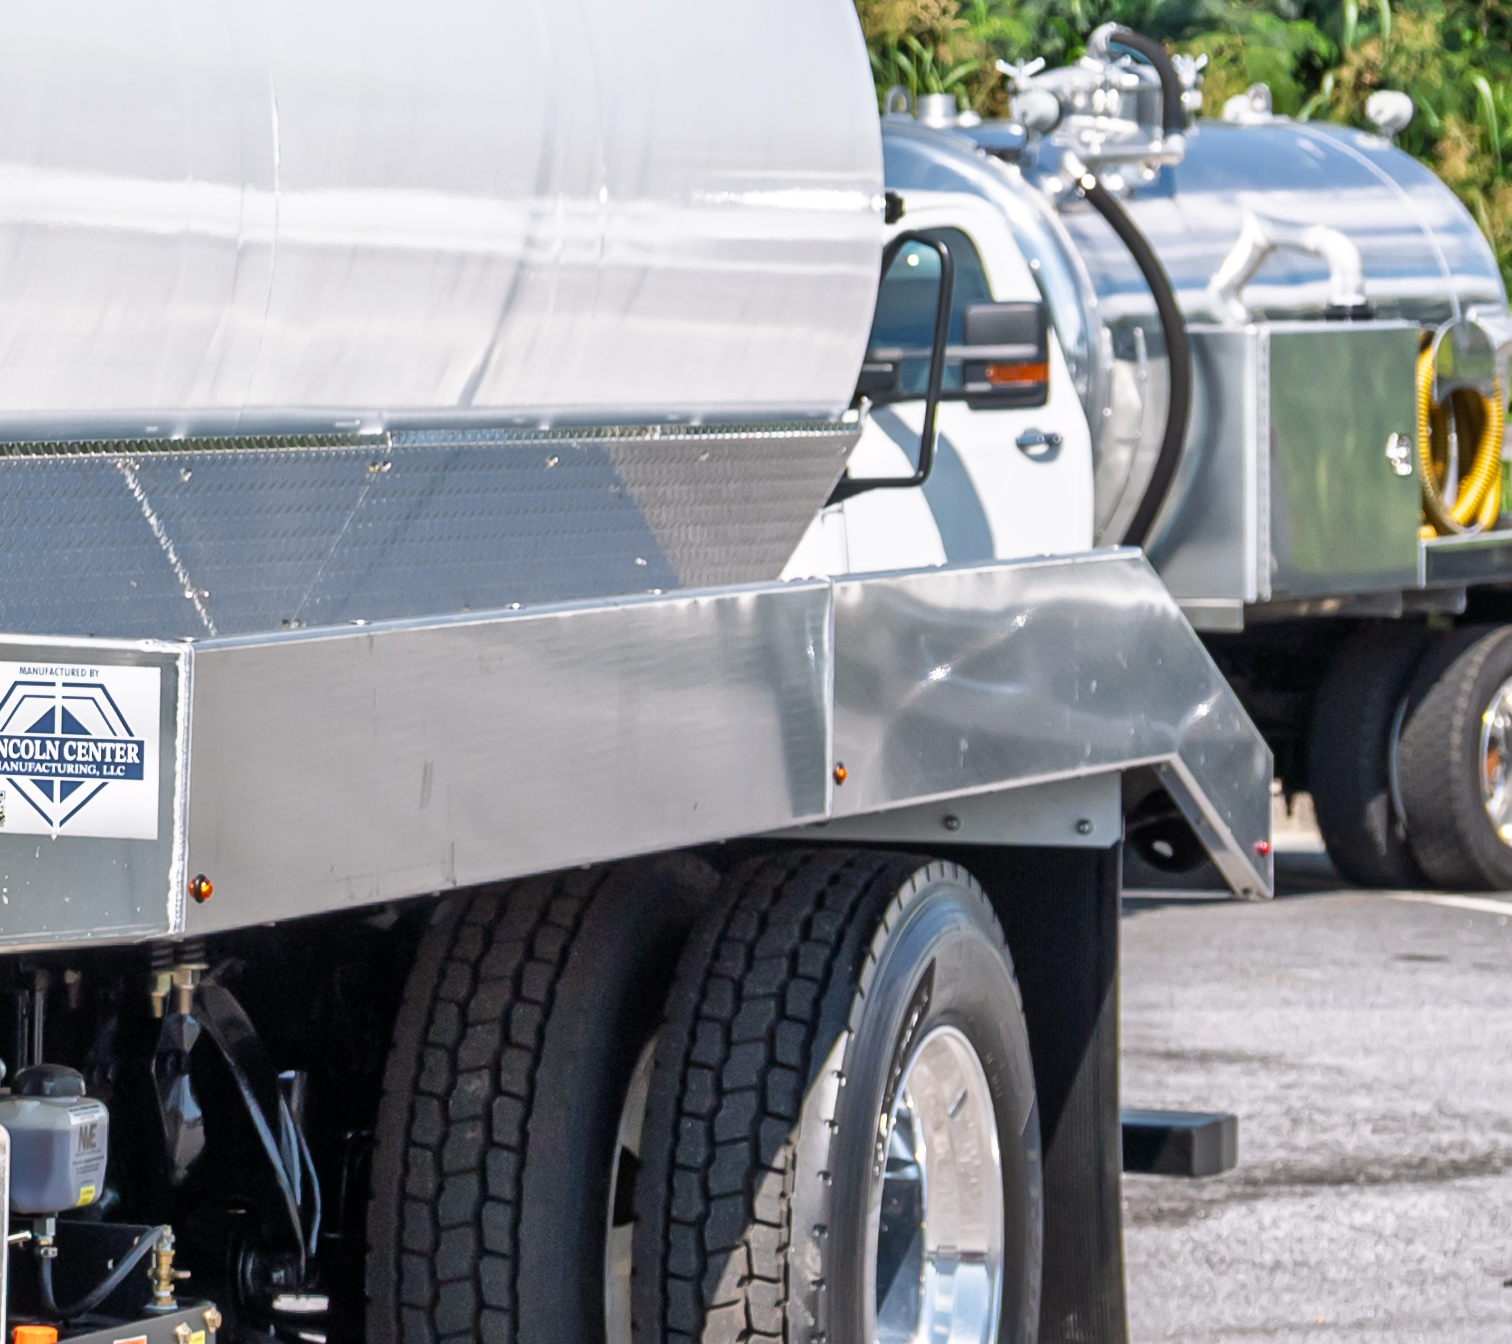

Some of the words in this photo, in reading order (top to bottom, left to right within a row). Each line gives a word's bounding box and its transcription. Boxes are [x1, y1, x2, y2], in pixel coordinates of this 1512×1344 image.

[19, 666, 87, 677] MANUFACTURED
[89, 668, 100, 678] BY
[63, 741, 140, 764] CENTER
[103, 765, 126, 776] LLC
